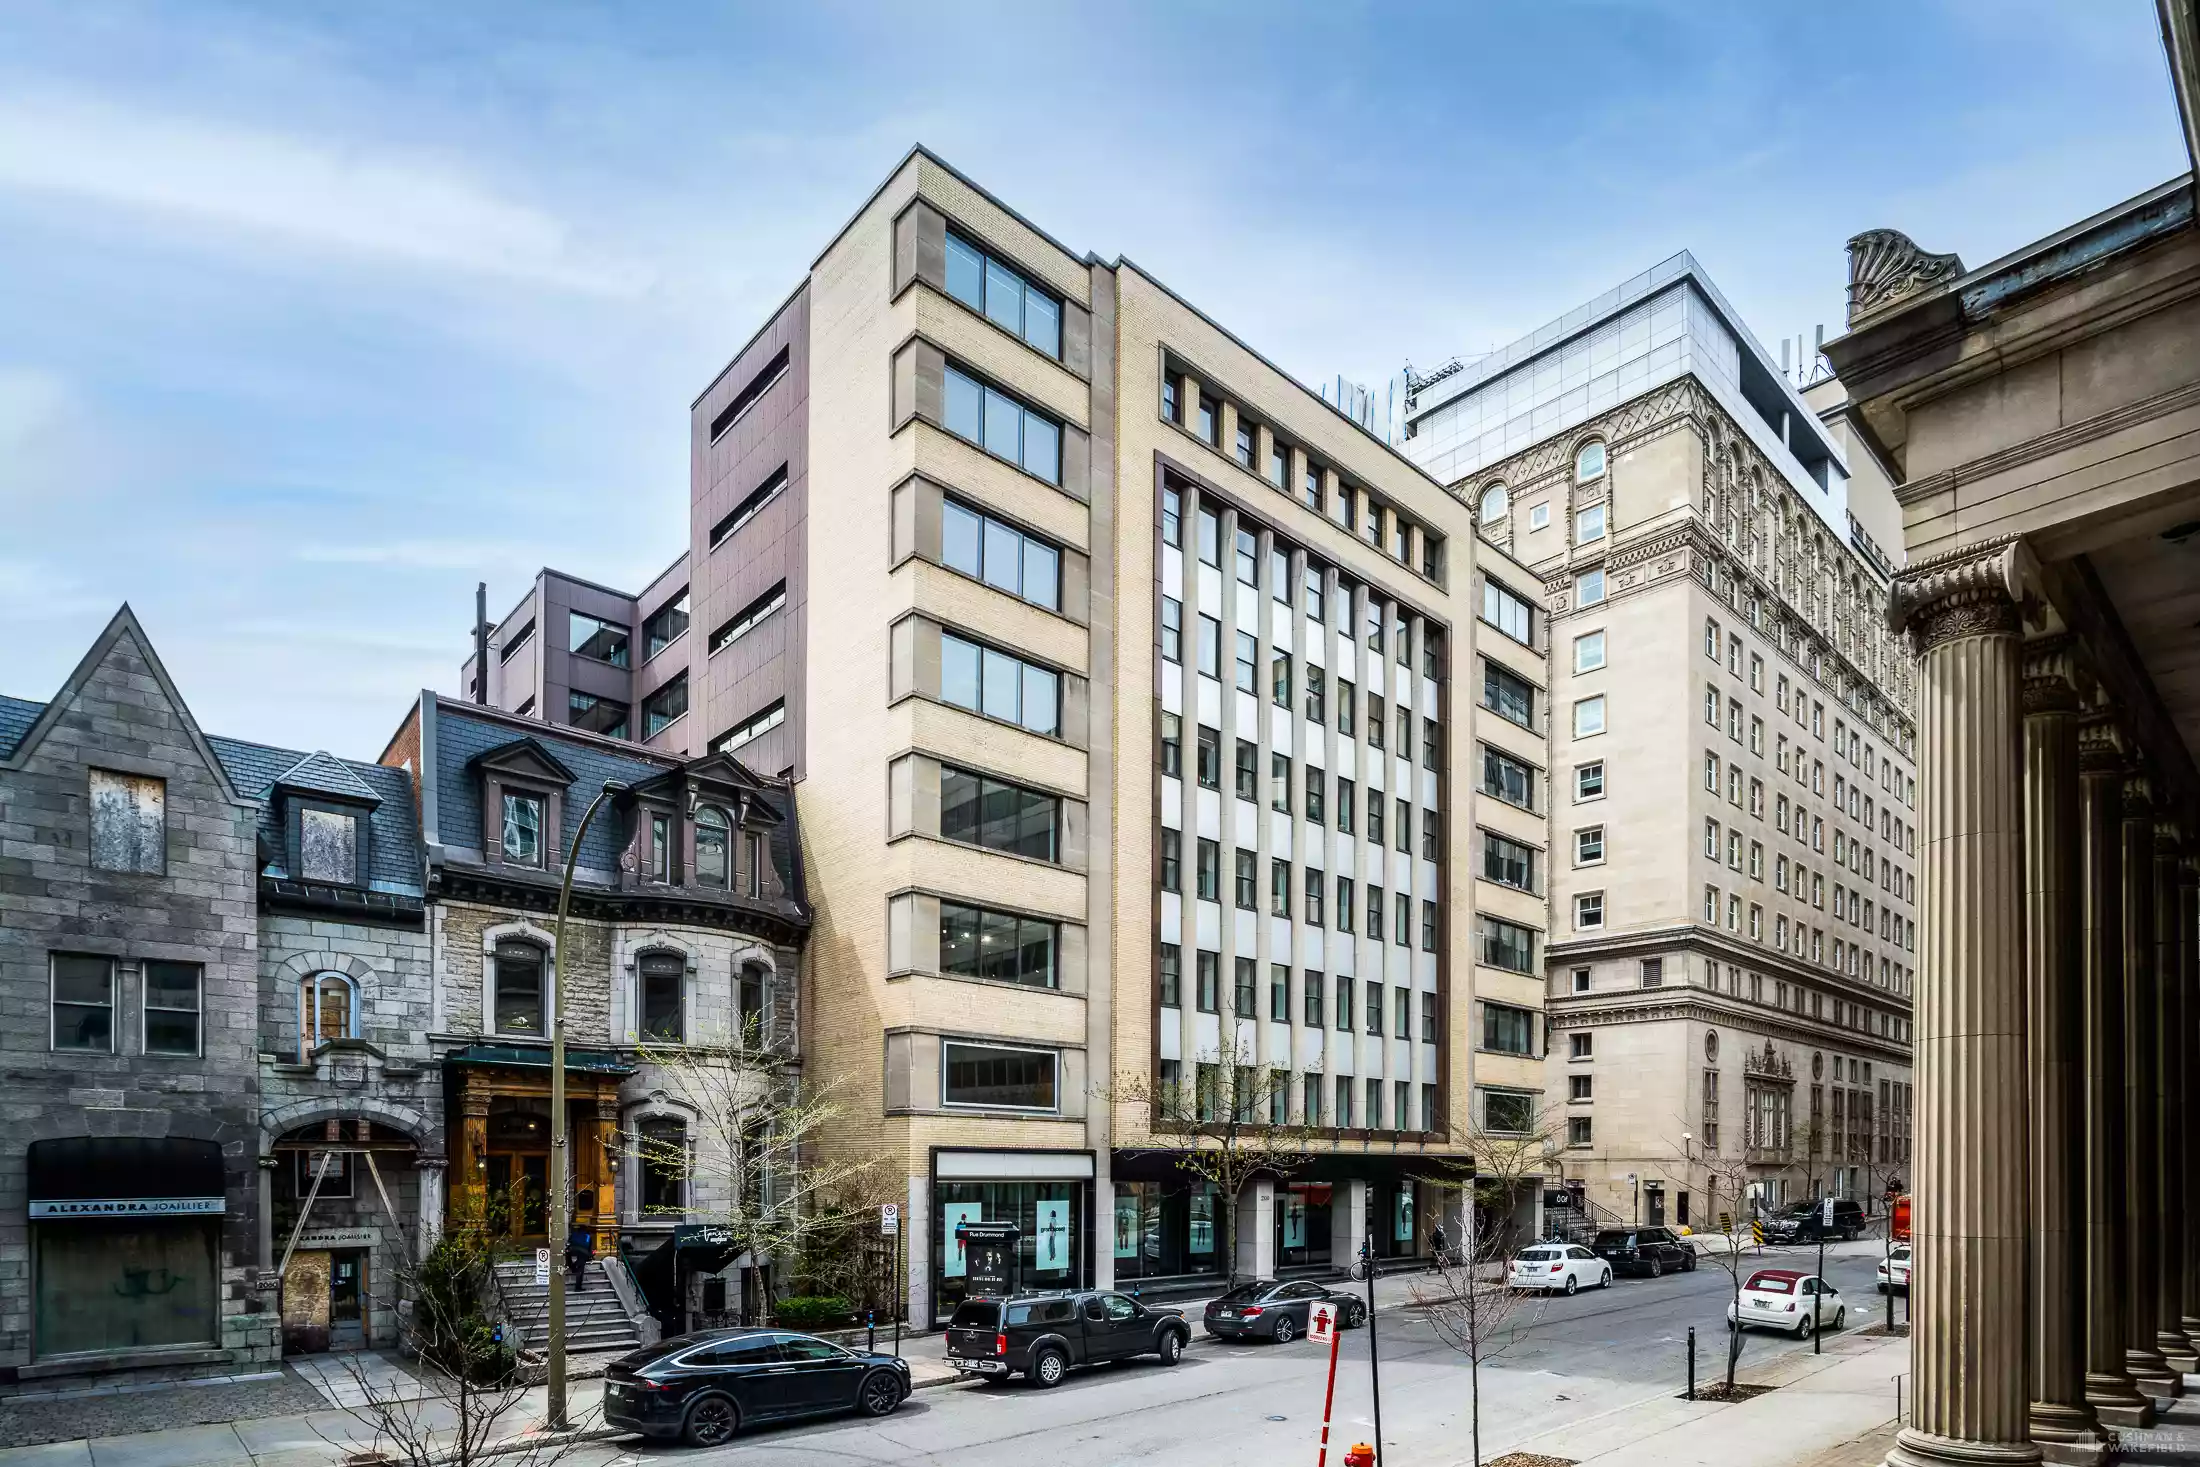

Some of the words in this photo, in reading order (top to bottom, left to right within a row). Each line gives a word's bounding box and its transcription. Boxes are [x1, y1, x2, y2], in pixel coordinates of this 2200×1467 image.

[47, 1203, 148, 1213] ALEXANDRA
[152, 1201, 211, 1212] JOAILLIER
[282, 1234, 336, 1242] XANDRA
